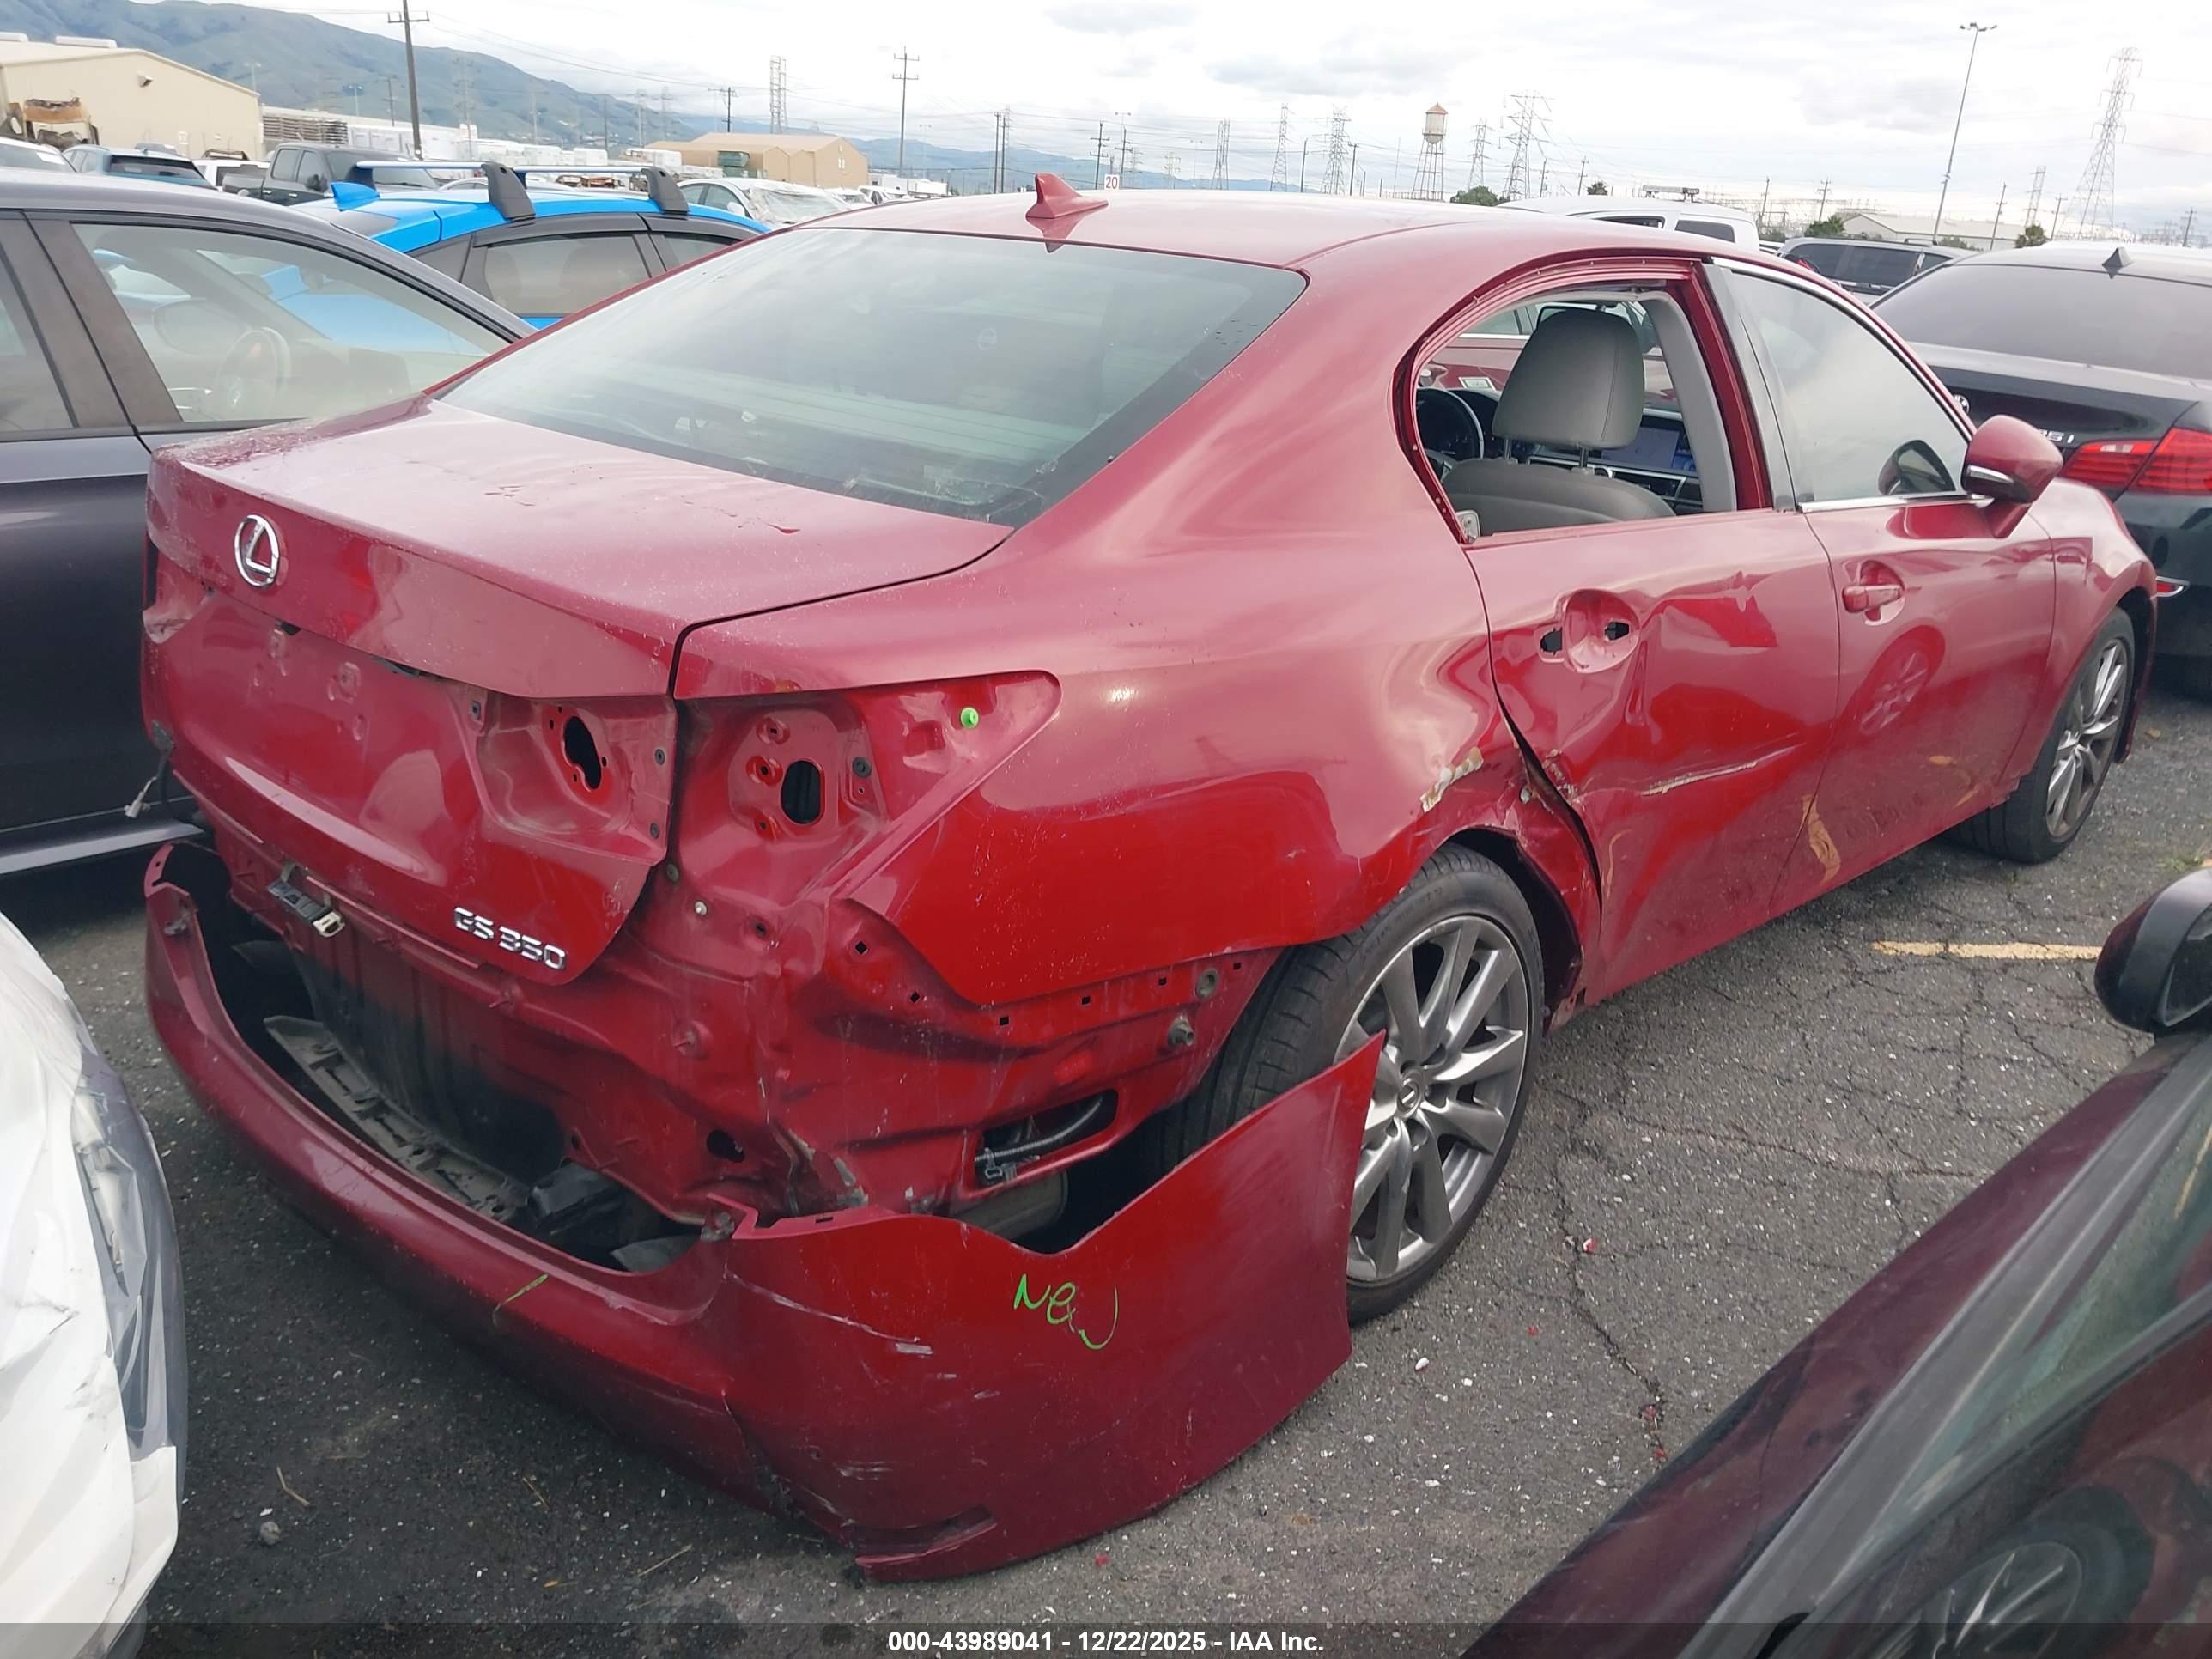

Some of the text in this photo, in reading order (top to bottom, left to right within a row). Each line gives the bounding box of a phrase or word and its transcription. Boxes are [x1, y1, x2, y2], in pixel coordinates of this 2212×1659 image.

[1105, 176, 1118, 190] 20
[453, 906, 568, 970] GS 350
